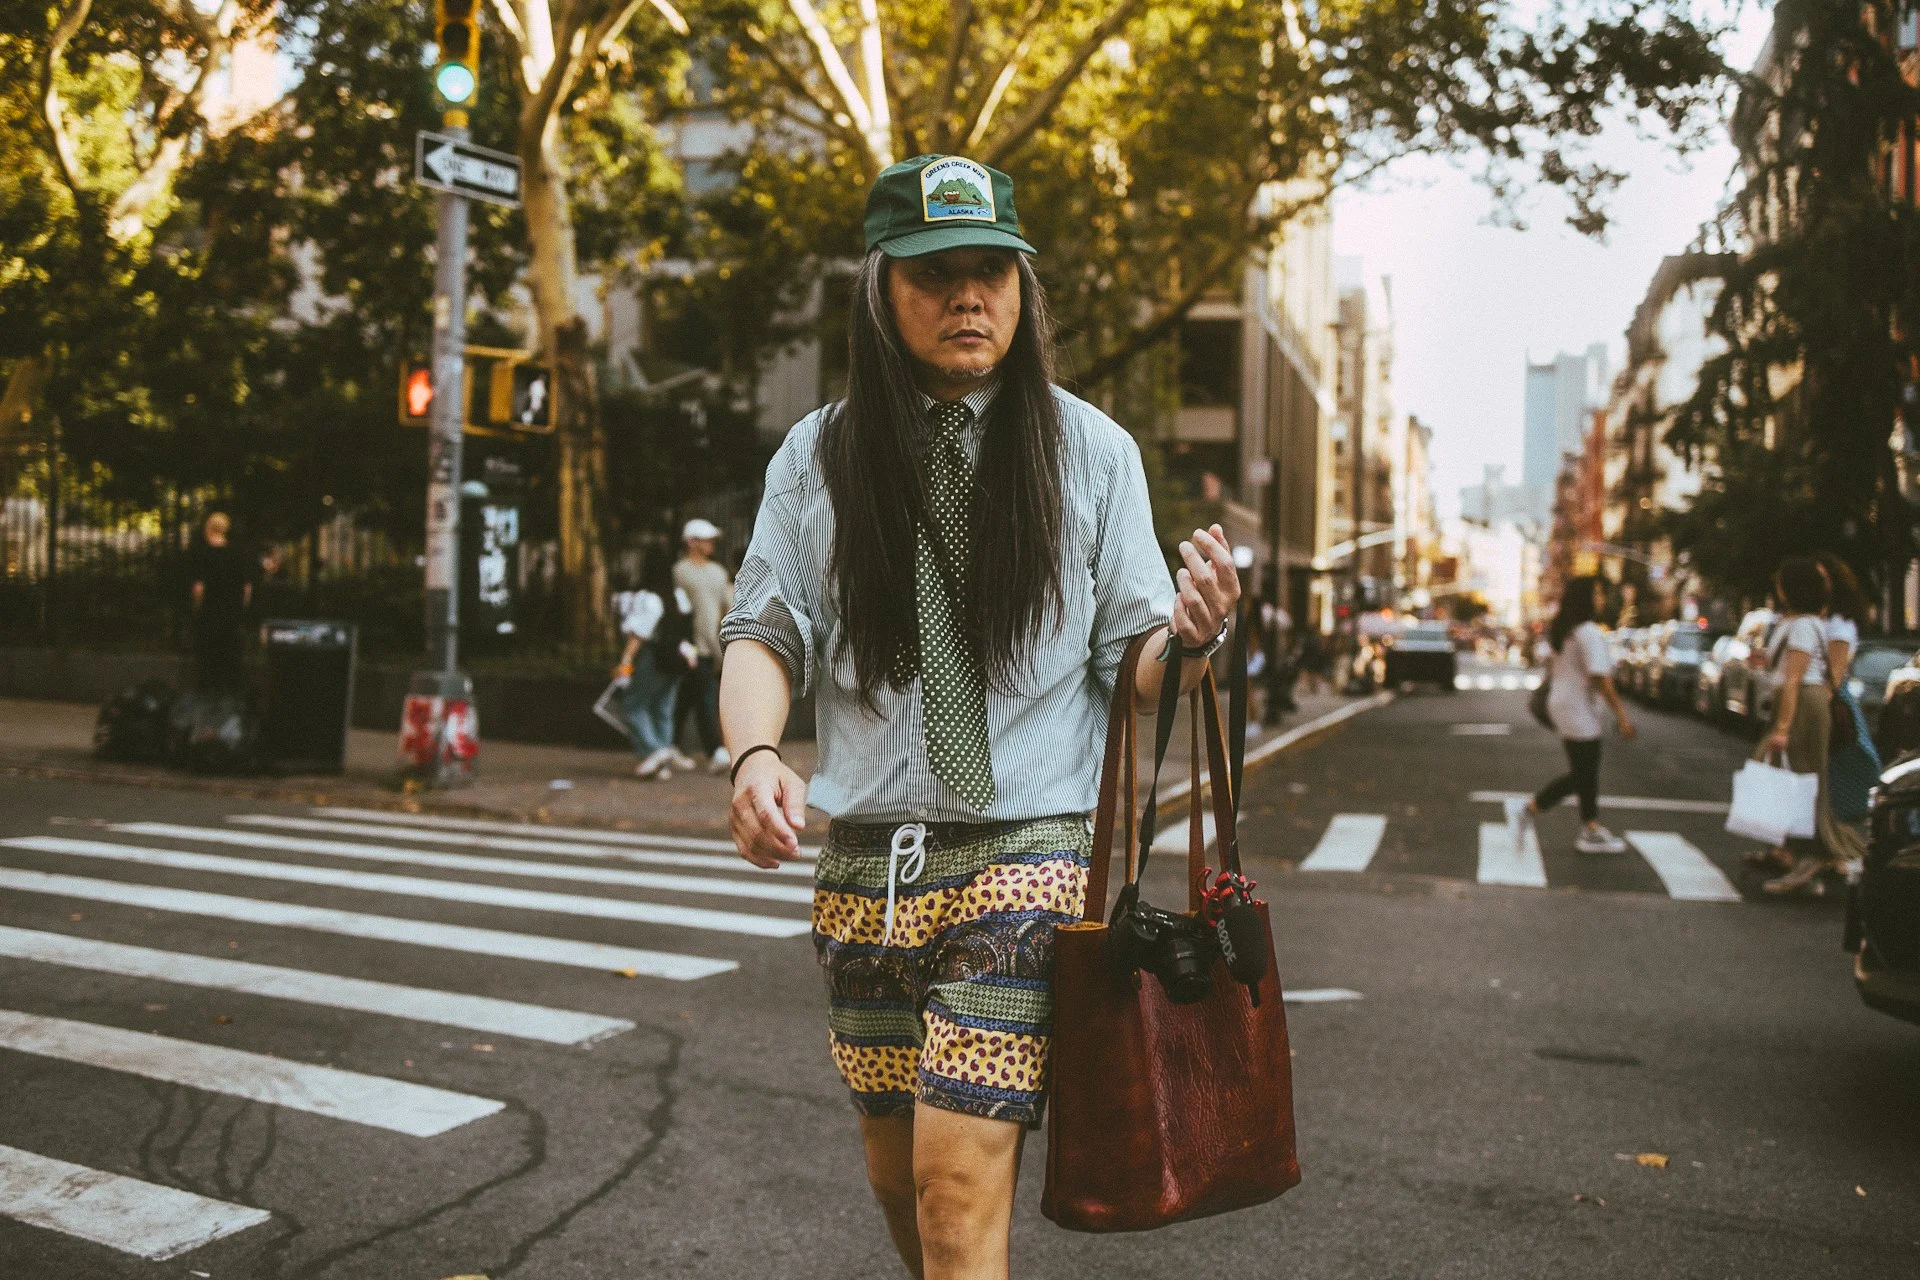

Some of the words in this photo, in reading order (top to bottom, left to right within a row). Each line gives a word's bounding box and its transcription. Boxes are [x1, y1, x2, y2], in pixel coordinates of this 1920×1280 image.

[925, 162, 950, 179] GREENS
[951, 161, 971, 169] CREEK
[972, 167, 986, 180] MINE
